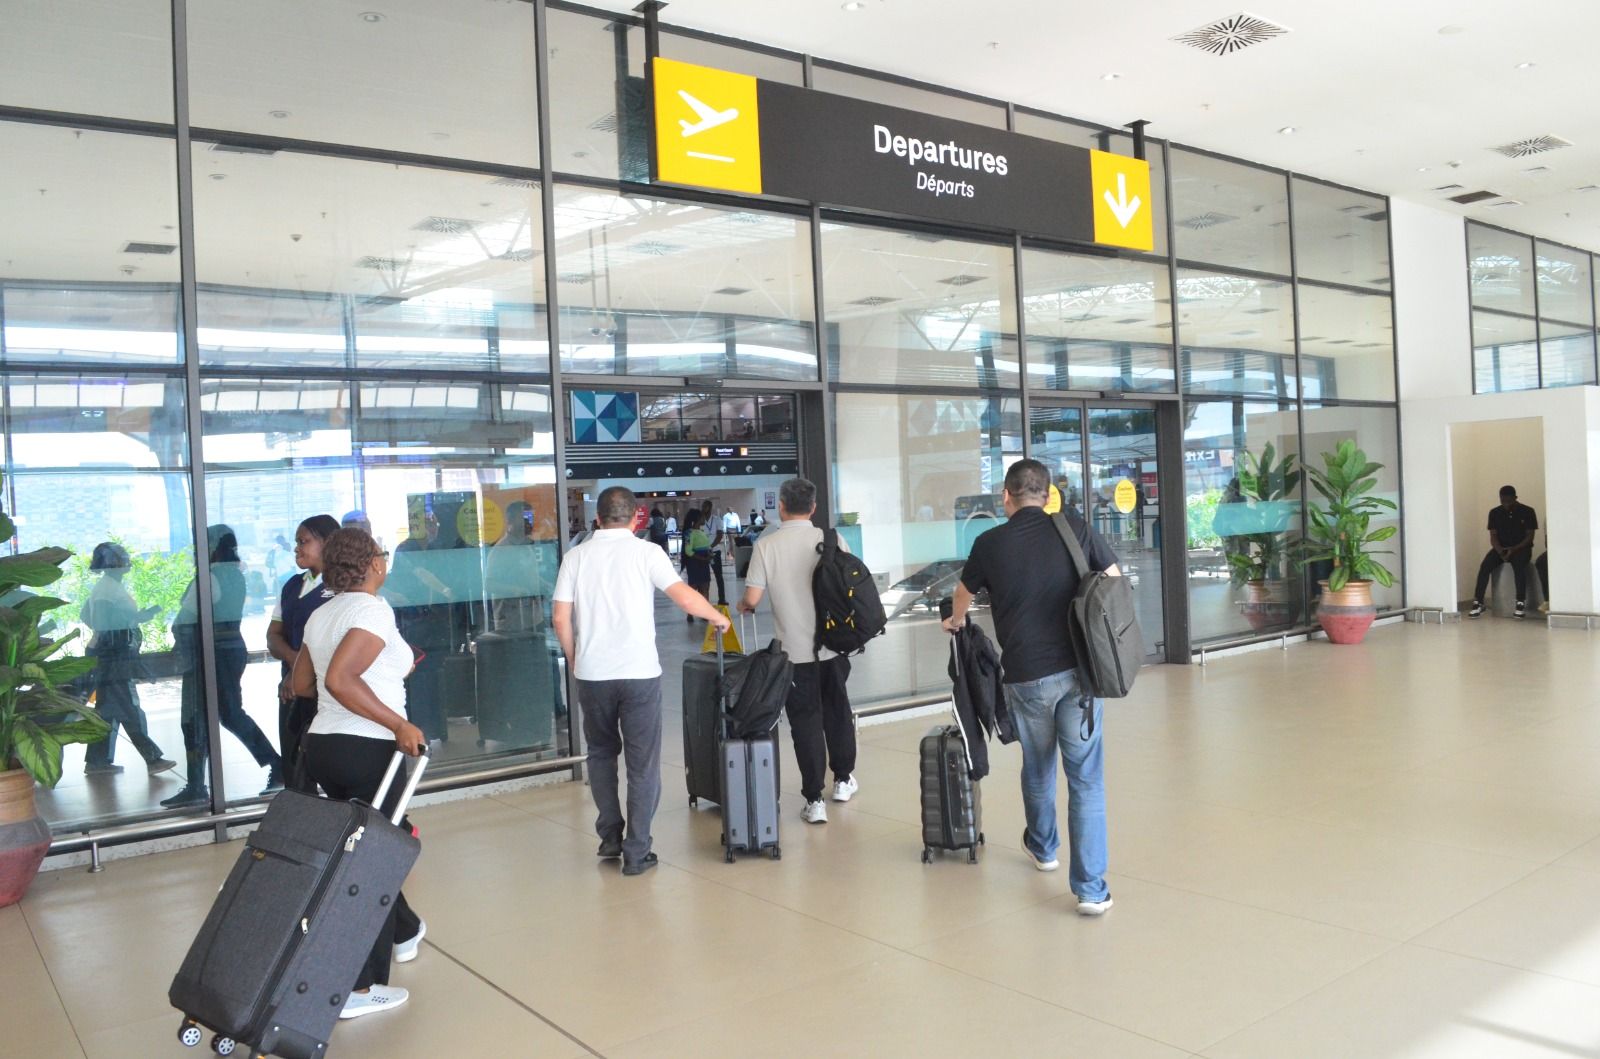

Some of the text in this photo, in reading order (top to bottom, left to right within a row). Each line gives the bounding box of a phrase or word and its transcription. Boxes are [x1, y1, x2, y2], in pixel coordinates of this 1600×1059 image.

[874, 125, 1008, 175] Departures
[916, 171, 975, 198] Départs
[463, 505, 495, 514] Cauon!
